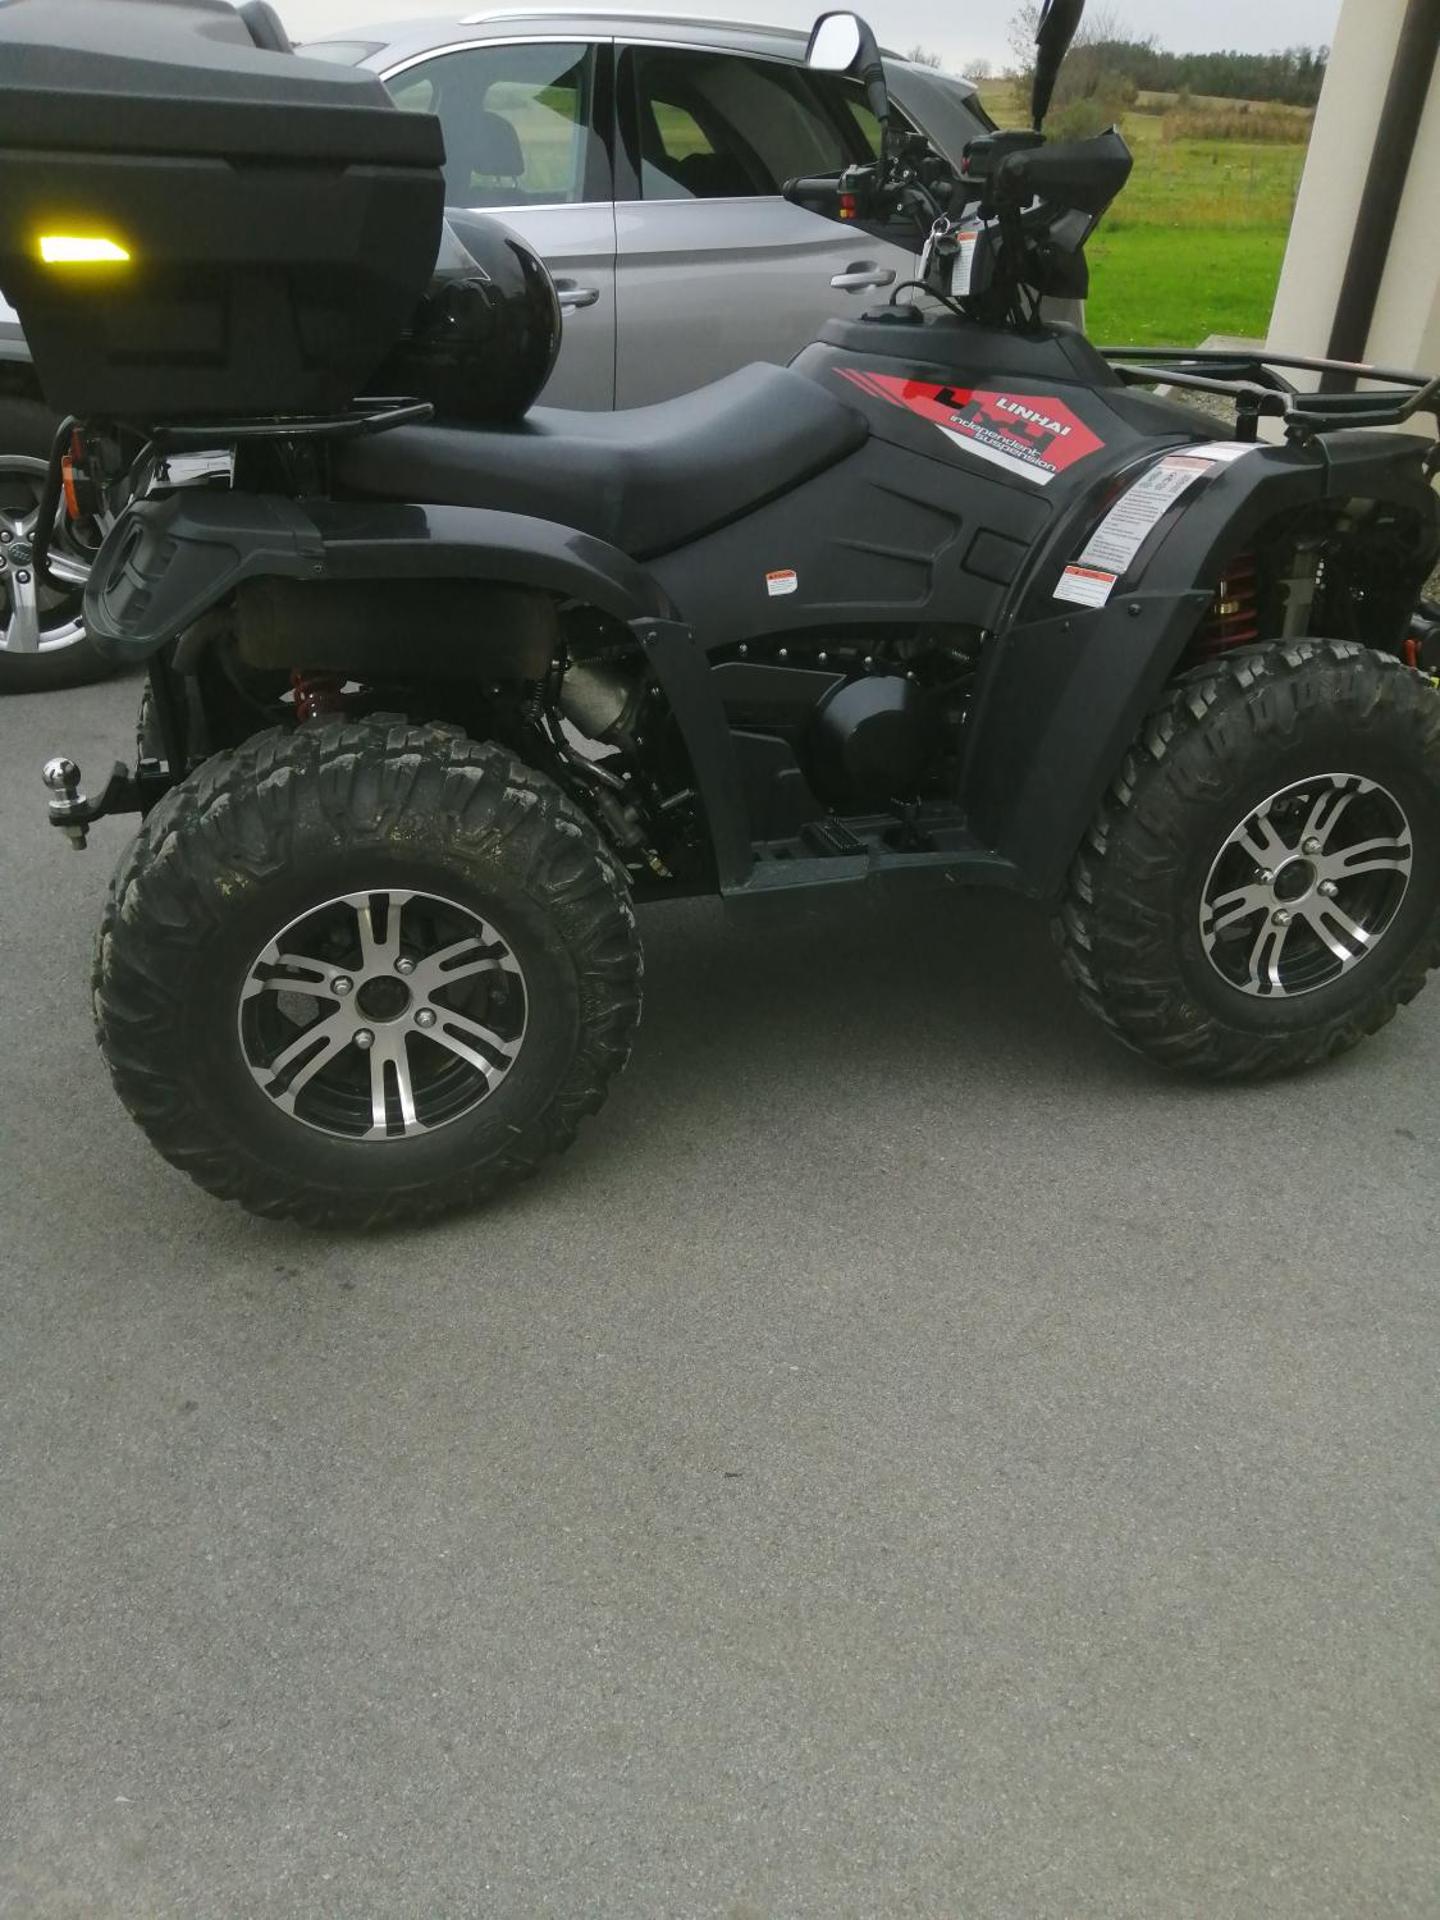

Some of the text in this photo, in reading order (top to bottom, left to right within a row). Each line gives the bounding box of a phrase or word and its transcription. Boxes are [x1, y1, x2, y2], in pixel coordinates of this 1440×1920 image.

[950, 415, 1041, 456] independent
[996, 398, 1071, 436] LINHAI
[974, 433, 1056, 471] suspension
